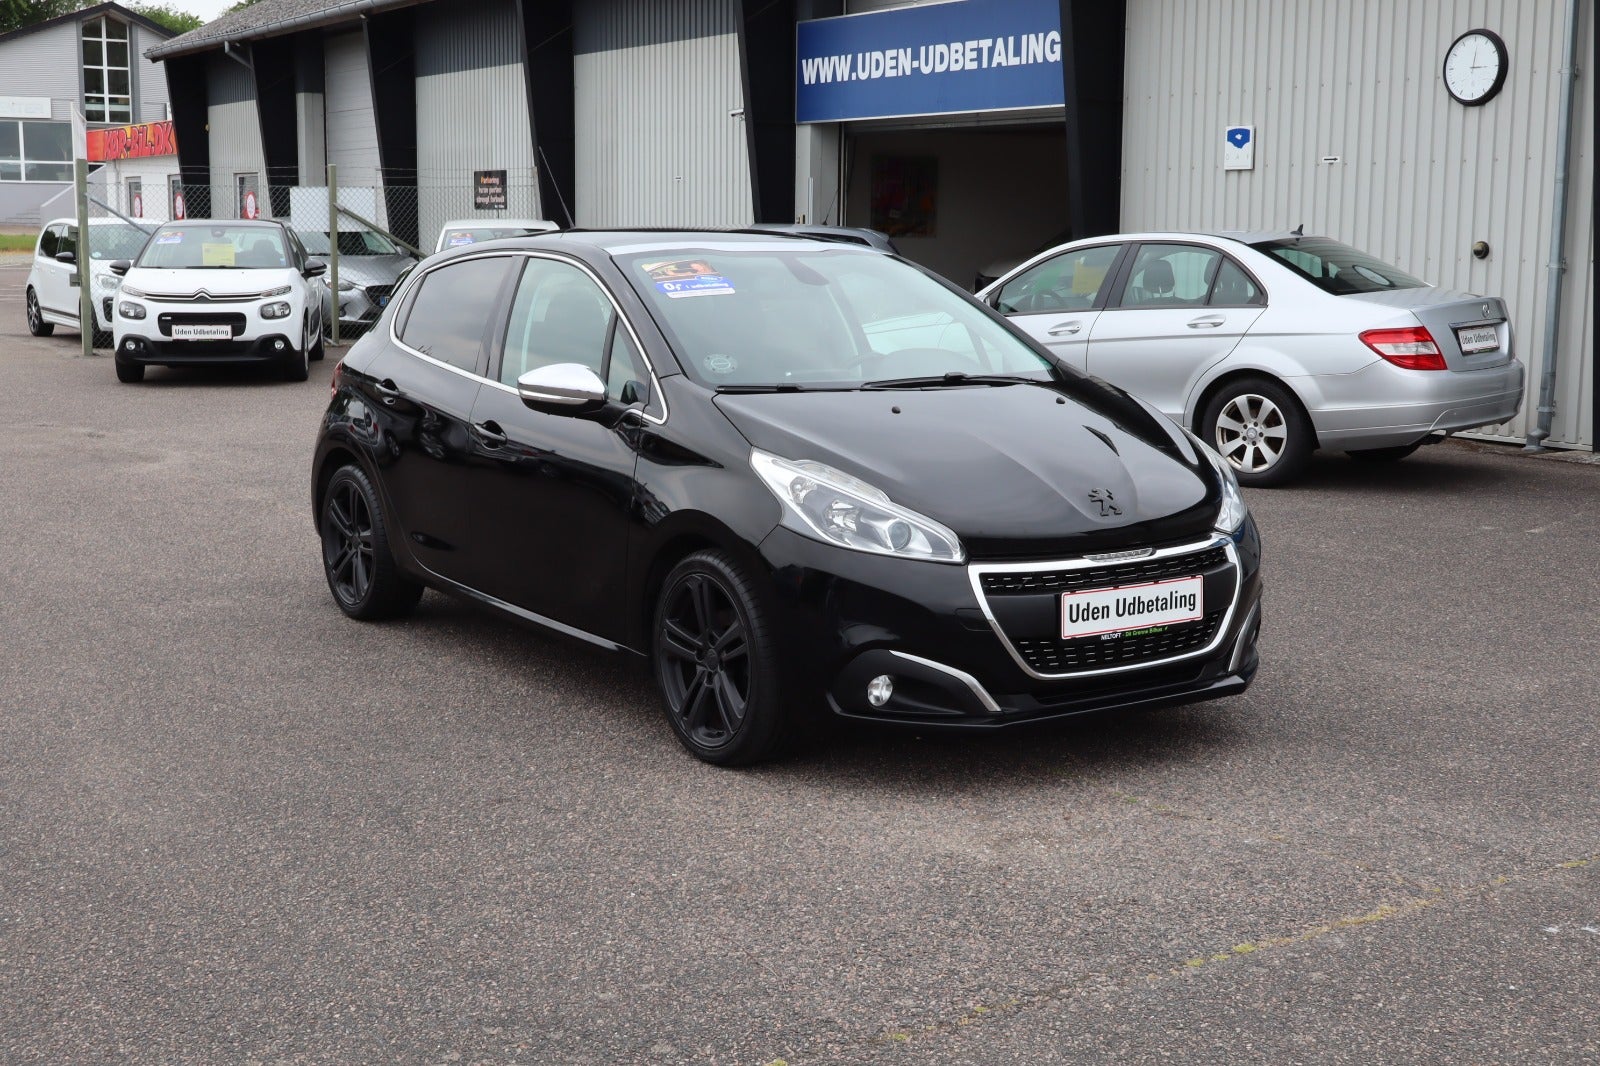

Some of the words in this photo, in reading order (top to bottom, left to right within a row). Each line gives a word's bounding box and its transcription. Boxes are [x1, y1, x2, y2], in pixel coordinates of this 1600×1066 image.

[801, 30, 1062, 85] WWW.UDEN-UDBETALING
[174, 328, 192, 336] Uden
[193, 328, 229, 336] Udbetaling
[1460, 333, 1474, 345] Uden
[1473, 331, 1497, 343] Udbetaling
[1069, 601, 1110, 624] Uden
[1115, 590, 1197, 618] Udbetaling
